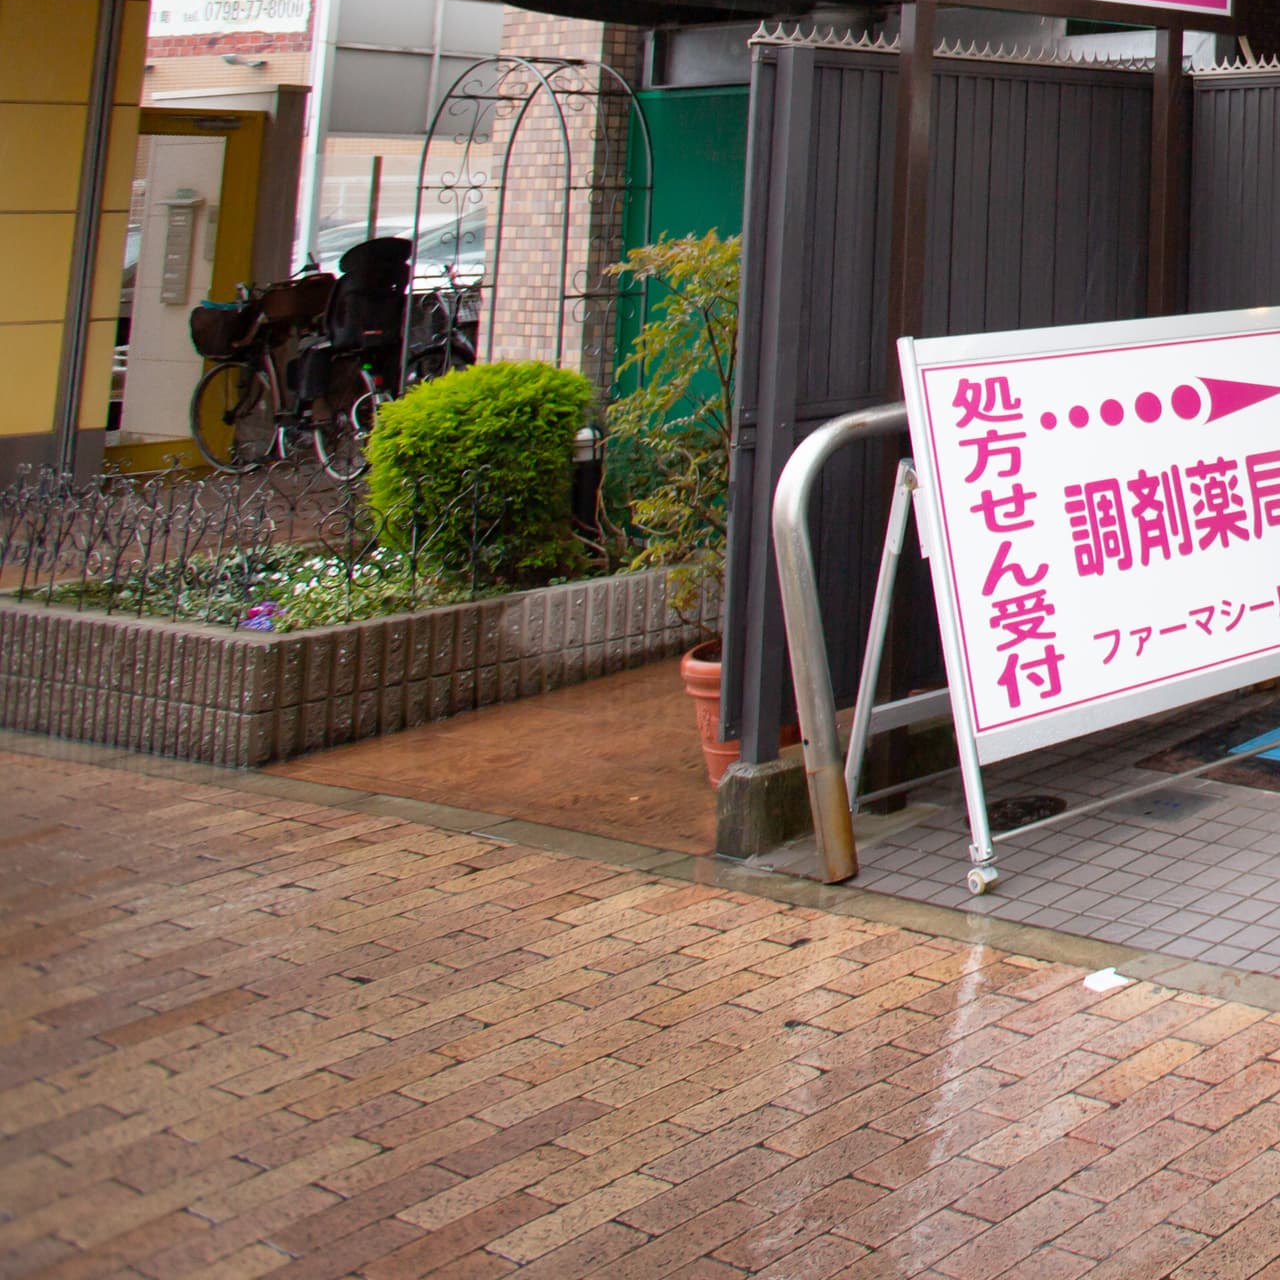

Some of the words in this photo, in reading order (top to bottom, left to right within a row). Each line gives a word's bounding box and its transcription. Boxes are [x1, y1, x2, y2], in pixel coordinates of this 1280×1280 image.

[952, 376, 1065, 708] 処方せん受付
